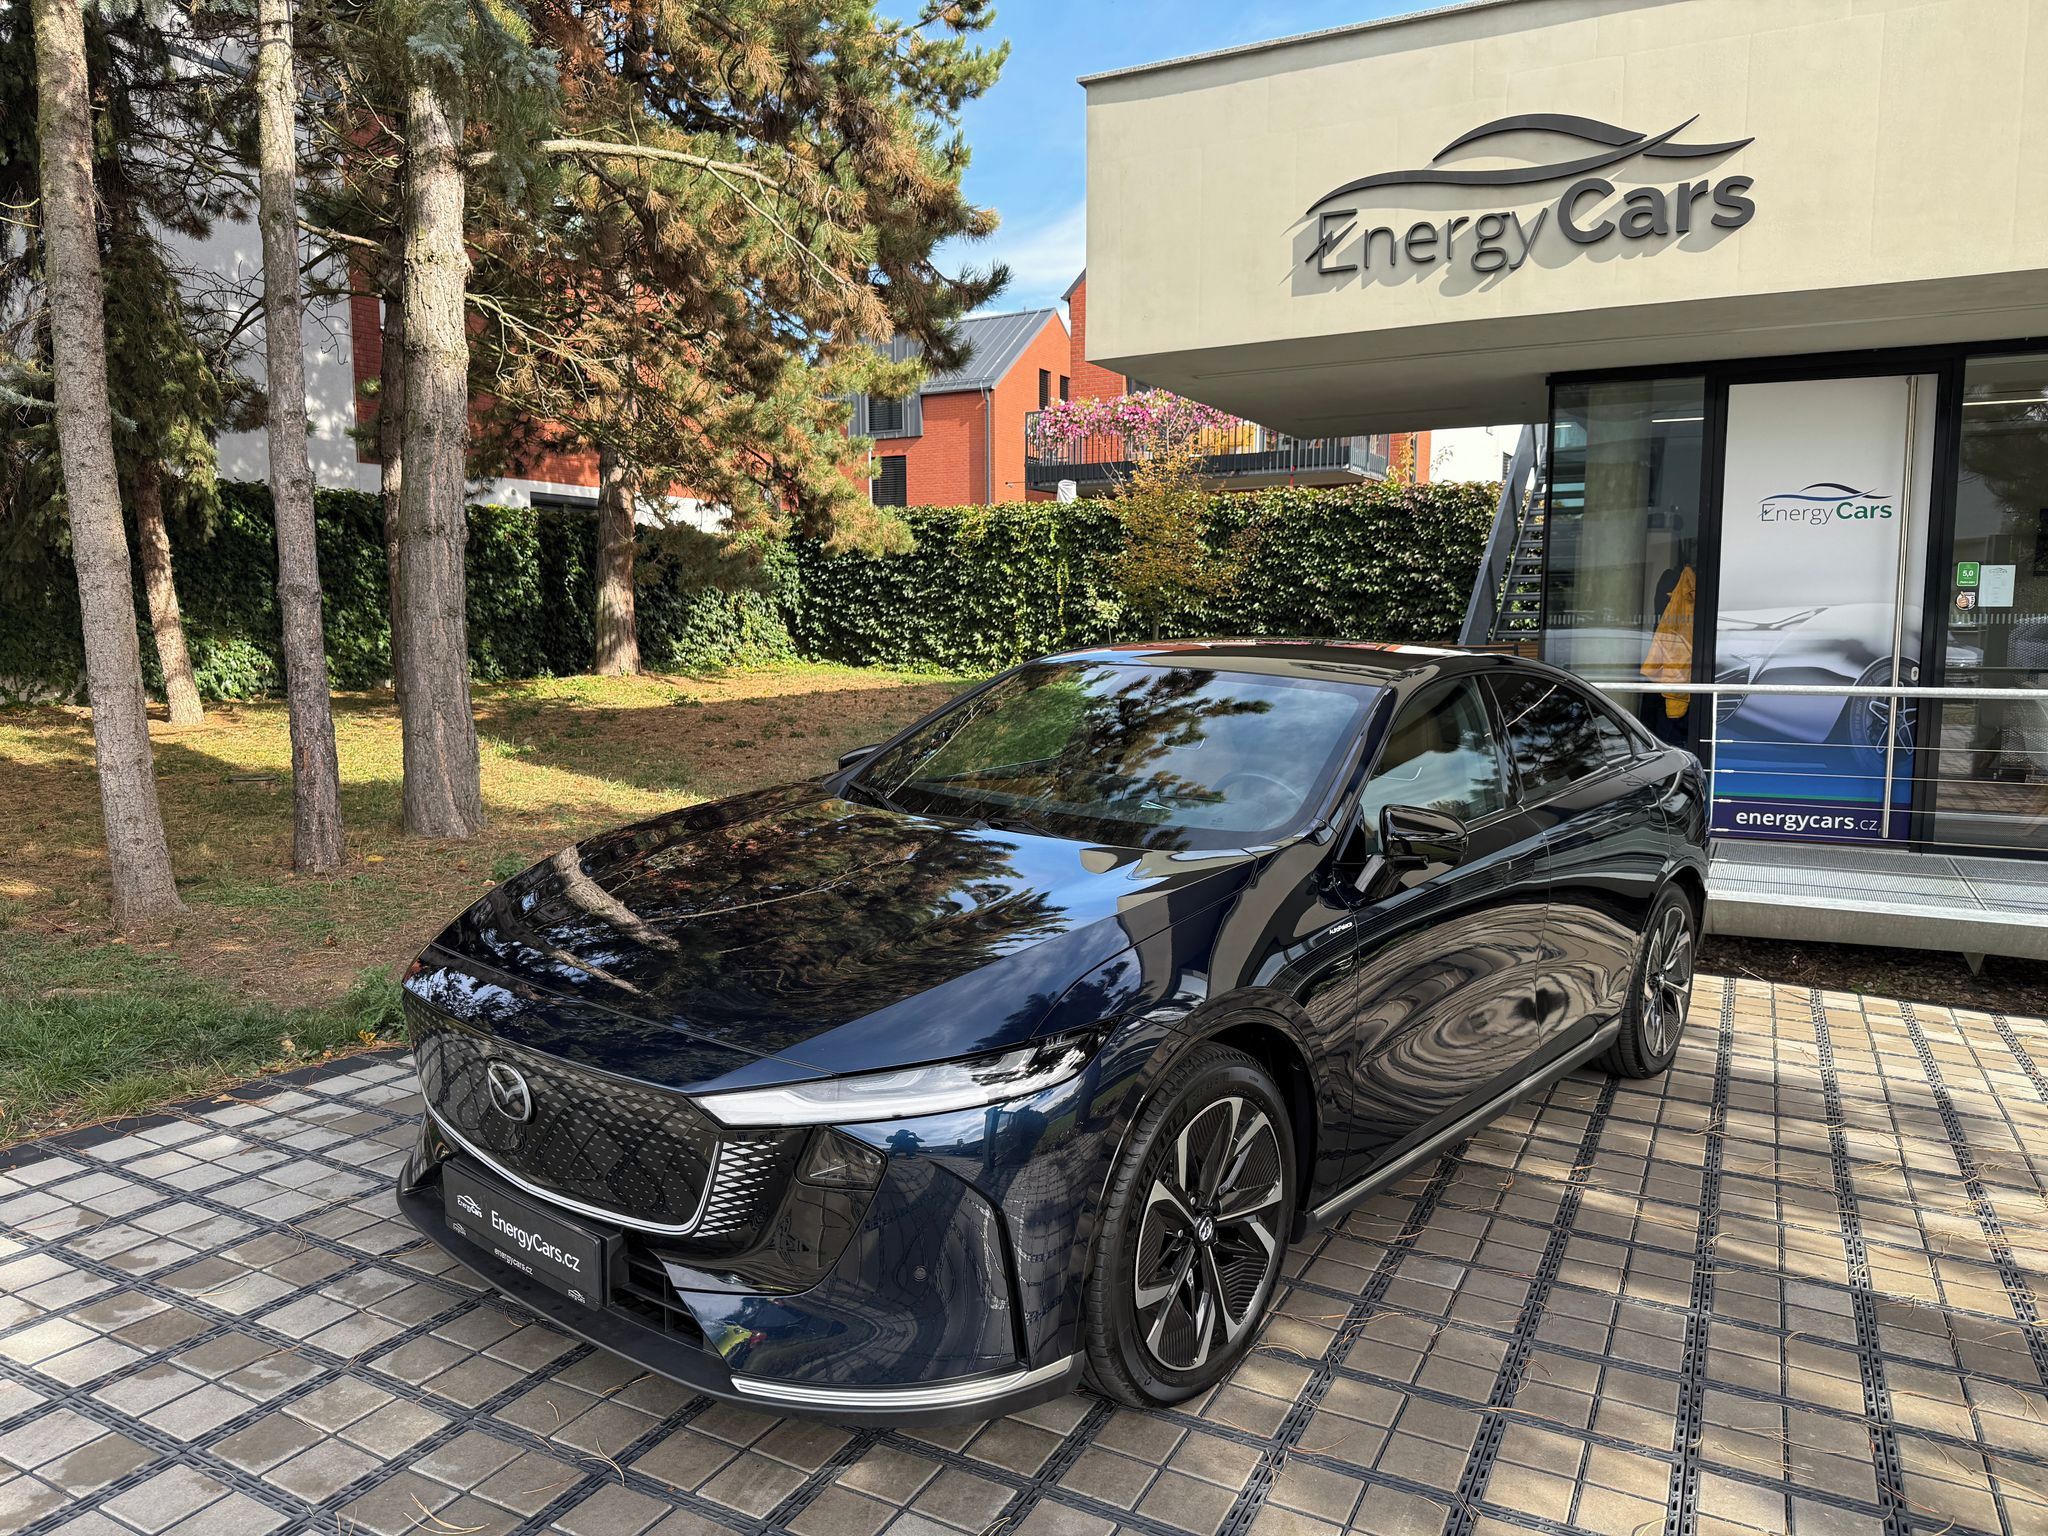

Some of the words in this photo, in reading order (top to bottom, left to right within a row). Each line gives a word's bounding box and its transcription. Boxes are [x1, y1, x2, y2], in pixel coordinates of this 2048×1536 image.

[1306, 175, 1756, 275] EnergyCars
[1735, 811, 1878, 832] energycars.cz
[491, 1209, 581, 1273] EnergyCars.cz
[494, 1247, 534, 1275] energycars.cz
